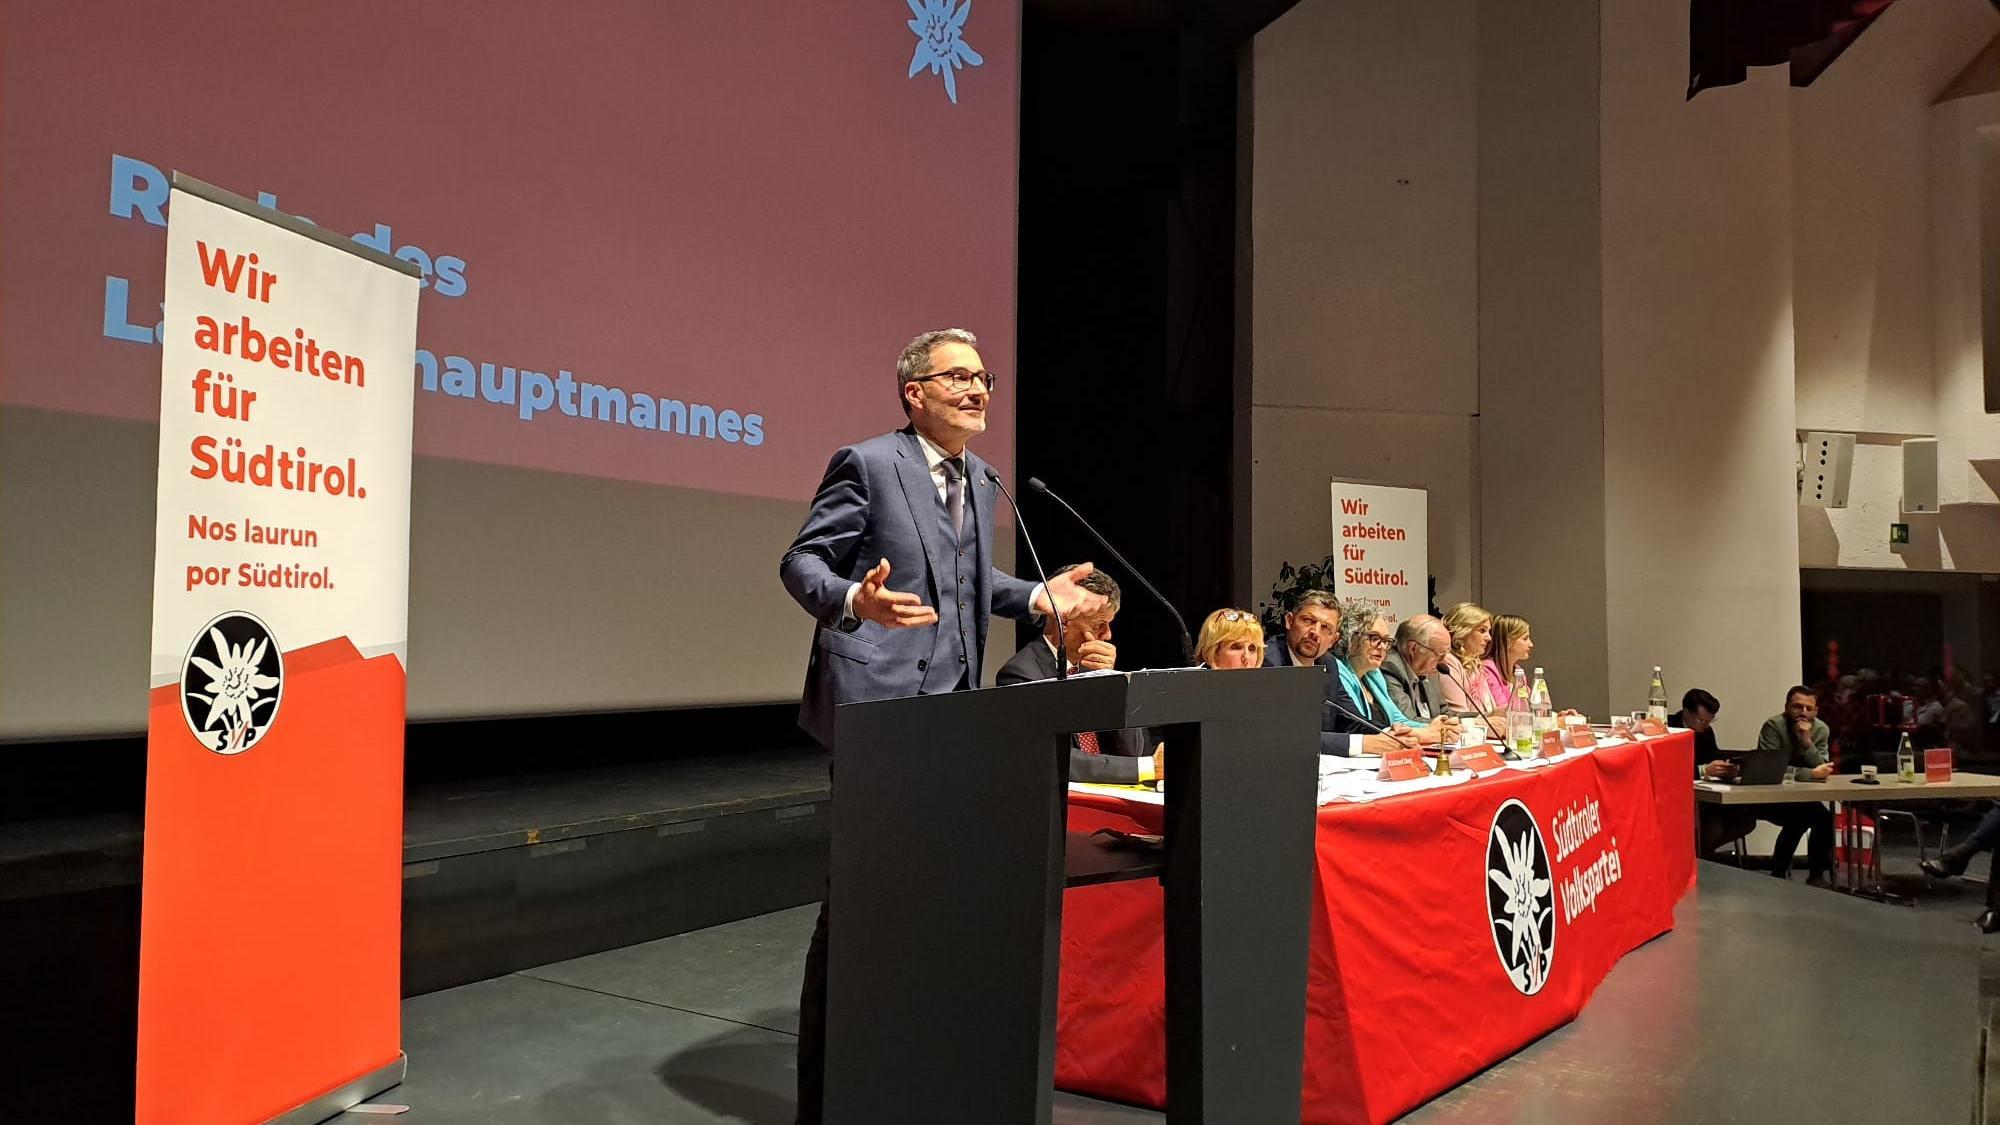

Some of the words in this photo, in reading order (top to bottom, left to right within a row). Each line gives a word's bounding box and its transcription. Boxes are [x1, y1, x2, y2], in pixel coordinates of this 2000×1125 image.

[196, 240, 277, 303] Wir
[194, 315, 365, 388] arbeiten
[192, 368, 257, 422] für
[190, 435, 367, 499] Südtirol.
[1341, 498, 1369, 516] Wir
[187, 514, 237, 542] Nos
[244, 518, 318, 548] laurun
[1342, 522, 1406, 541] arbeiten
[1343, 544, 1366, 561] für
[186, 564, 231, 591] por
[238, 563, 334, 590] Südtirol.
[1344, 567, 1409, 586] Südtirol.
[216, 722, 257, 751] SVP
[1552, 794, 1602, 862] Südtiroler
[1560, 837, 1623, 925] Volkspartei
[1523, 946, 1547, 992] SVP
